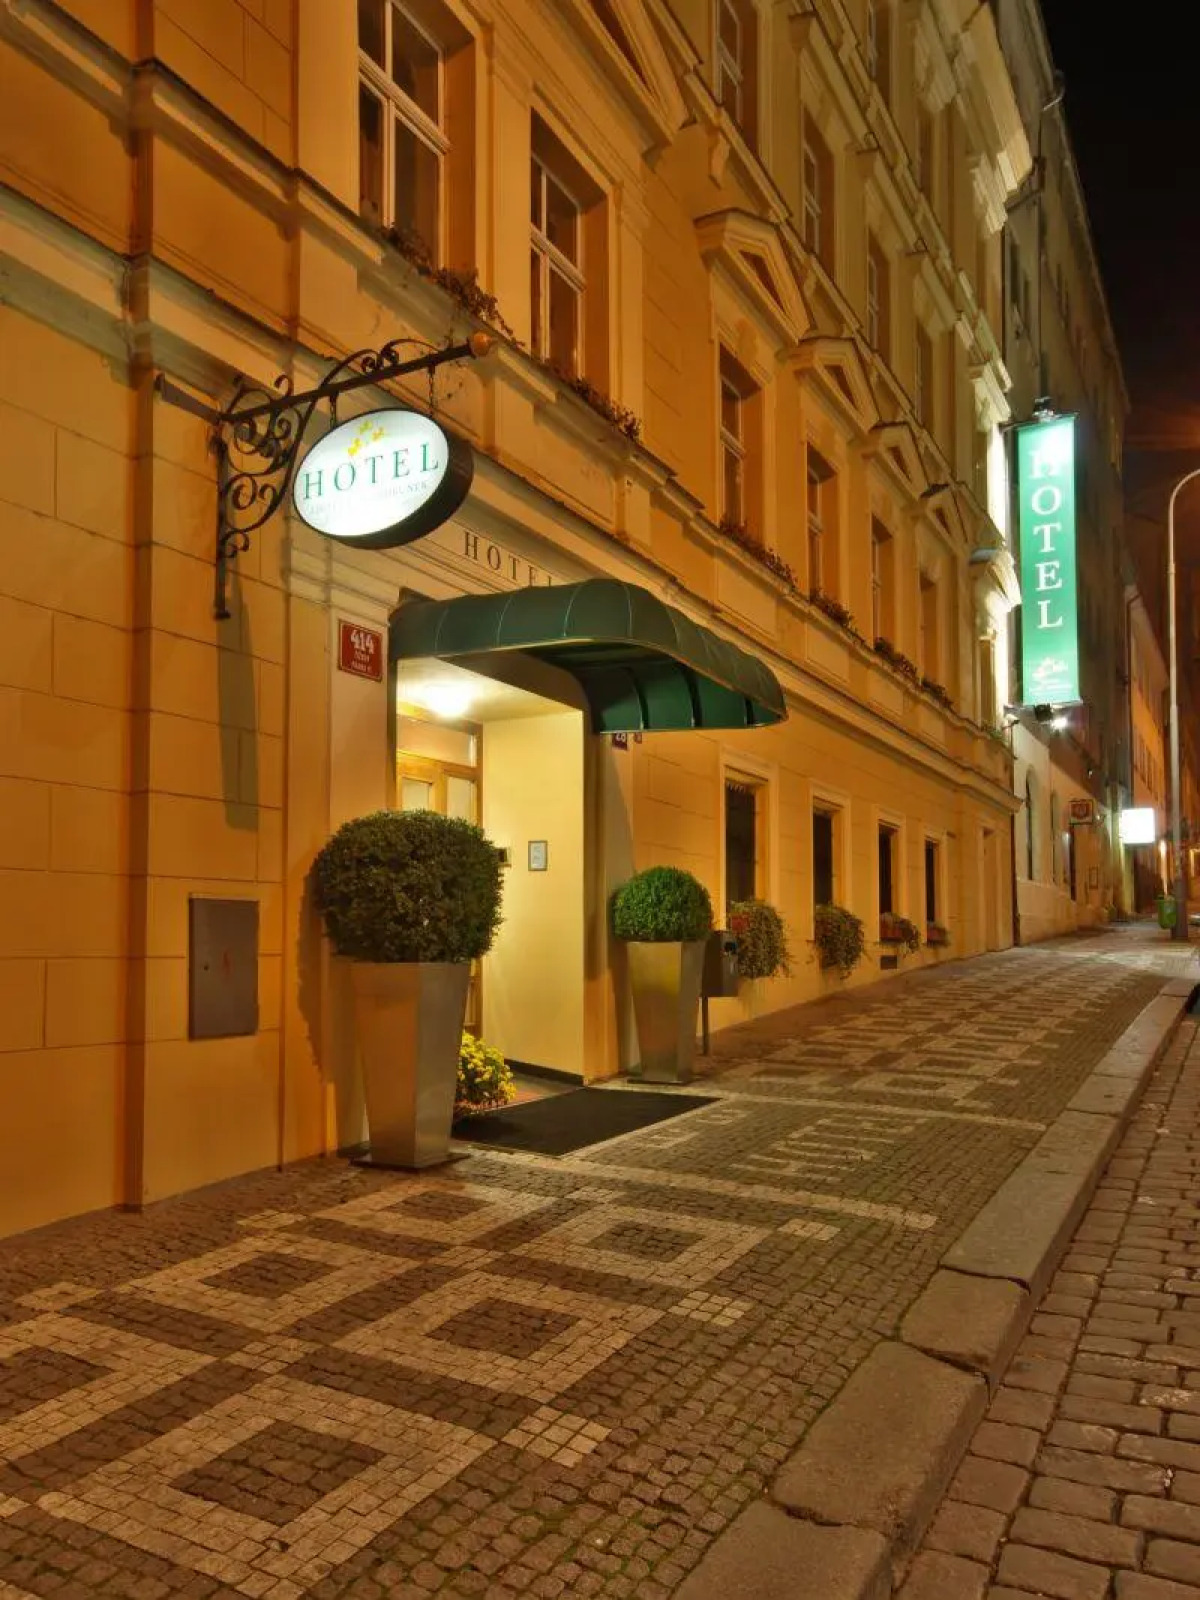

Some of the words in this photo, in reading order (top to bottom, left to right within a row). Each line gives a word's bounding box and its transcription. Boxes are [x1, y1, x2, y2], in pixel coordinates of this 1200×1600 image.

[303, 442, 439, 500] HOTEL
[1029, 449, 1062, 629] HOTEL
[350, 629, 374, 655] 414
